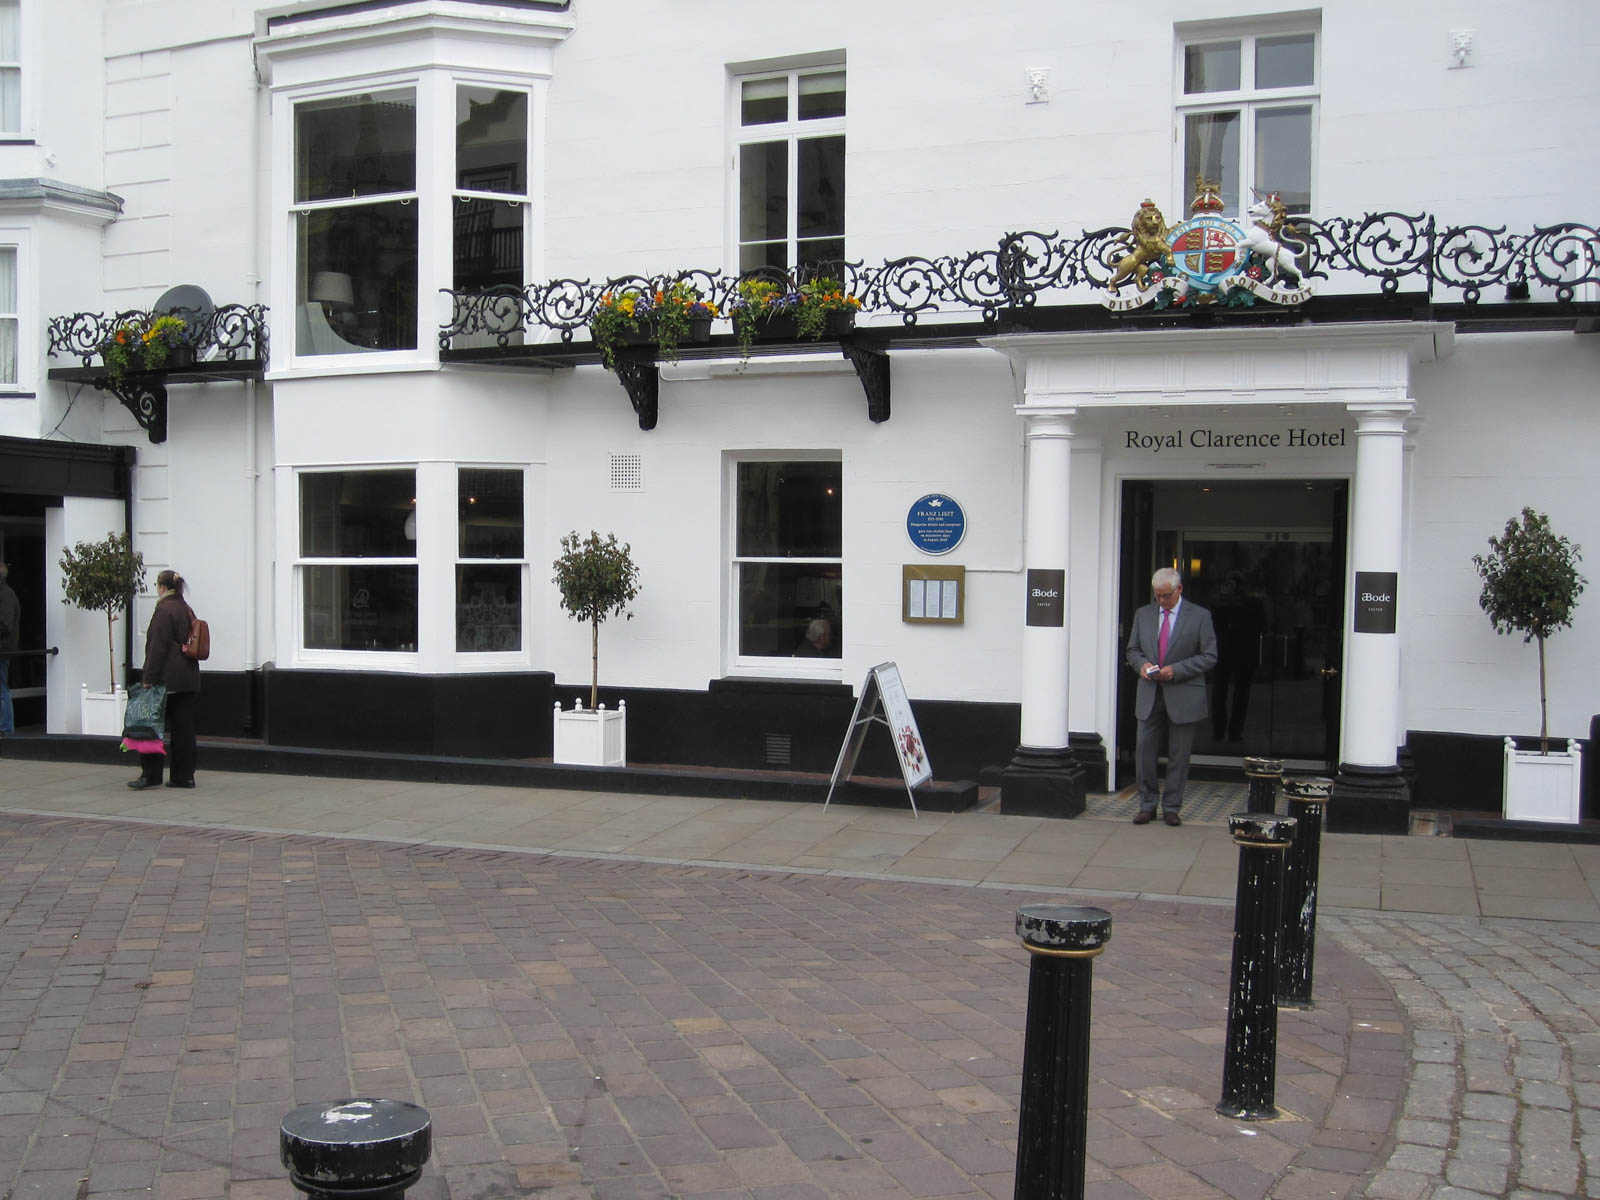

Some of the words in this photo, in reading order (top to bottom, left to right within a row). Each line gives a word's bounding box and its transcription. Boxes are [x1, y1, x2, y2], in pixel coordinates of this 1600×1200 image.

[1108, 296, 1144, 310] DIEU
[1225, 277, 1259, 291] MON
[1270, 287, 1313, 304] DROIT
[1125, 429, 1184, 453] Royal
[1190, 429, 1281, 448] Clarence
[1287, 428, 1346, 447] Hotel
[127, 702, 162, 719] M&S
